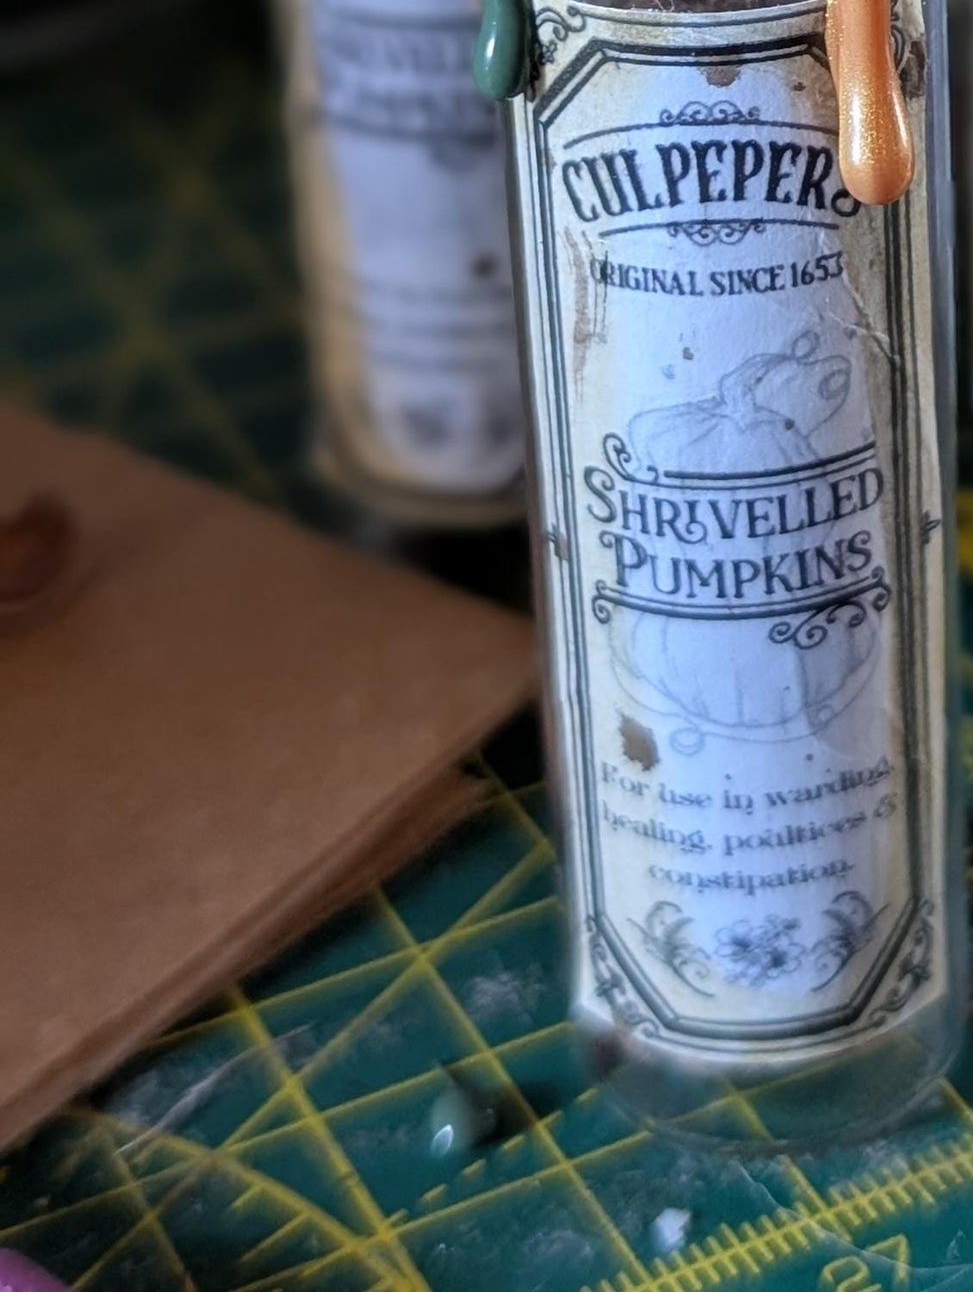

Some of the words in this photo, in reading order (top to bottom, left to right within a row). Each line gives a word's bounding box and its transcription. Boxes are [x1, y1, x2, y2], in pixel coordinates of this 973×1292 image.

[590, 256, 704, 296] ORIGINAL
[709, 264, 785, 295] SINCE
[790, 250, 844, 289] 1653
[584, 465, 885, 545] SHRIVELLED
[600, 529, 873, 600] PUMPKINS
[601, 760, 649, 798] For
[659, 783, 713, 808] use
[722, 789, 755, 815] in
